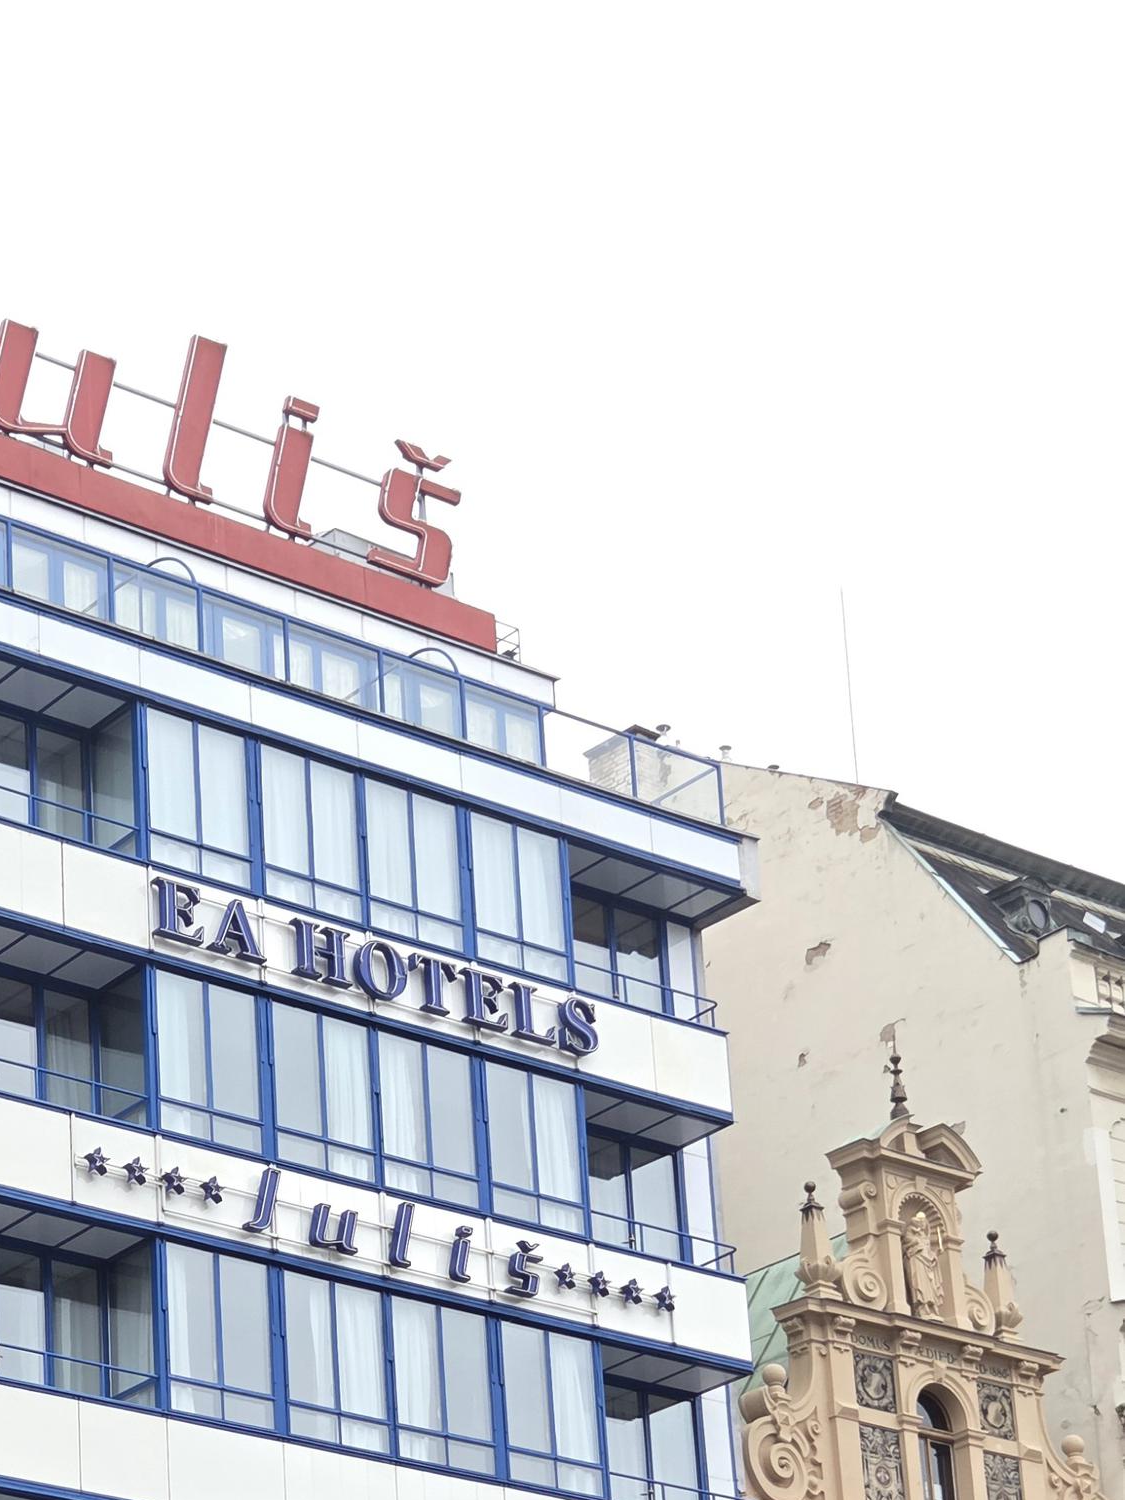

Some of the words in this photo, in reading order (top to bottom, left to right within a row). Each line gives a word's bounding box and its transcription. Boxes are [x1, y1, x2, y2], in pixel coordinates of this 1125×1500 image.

[150, 875, 267, 964] EA
[288, 917, 599, 1057] HOTELS
[242, 1165, 544, 1298] Juliš
